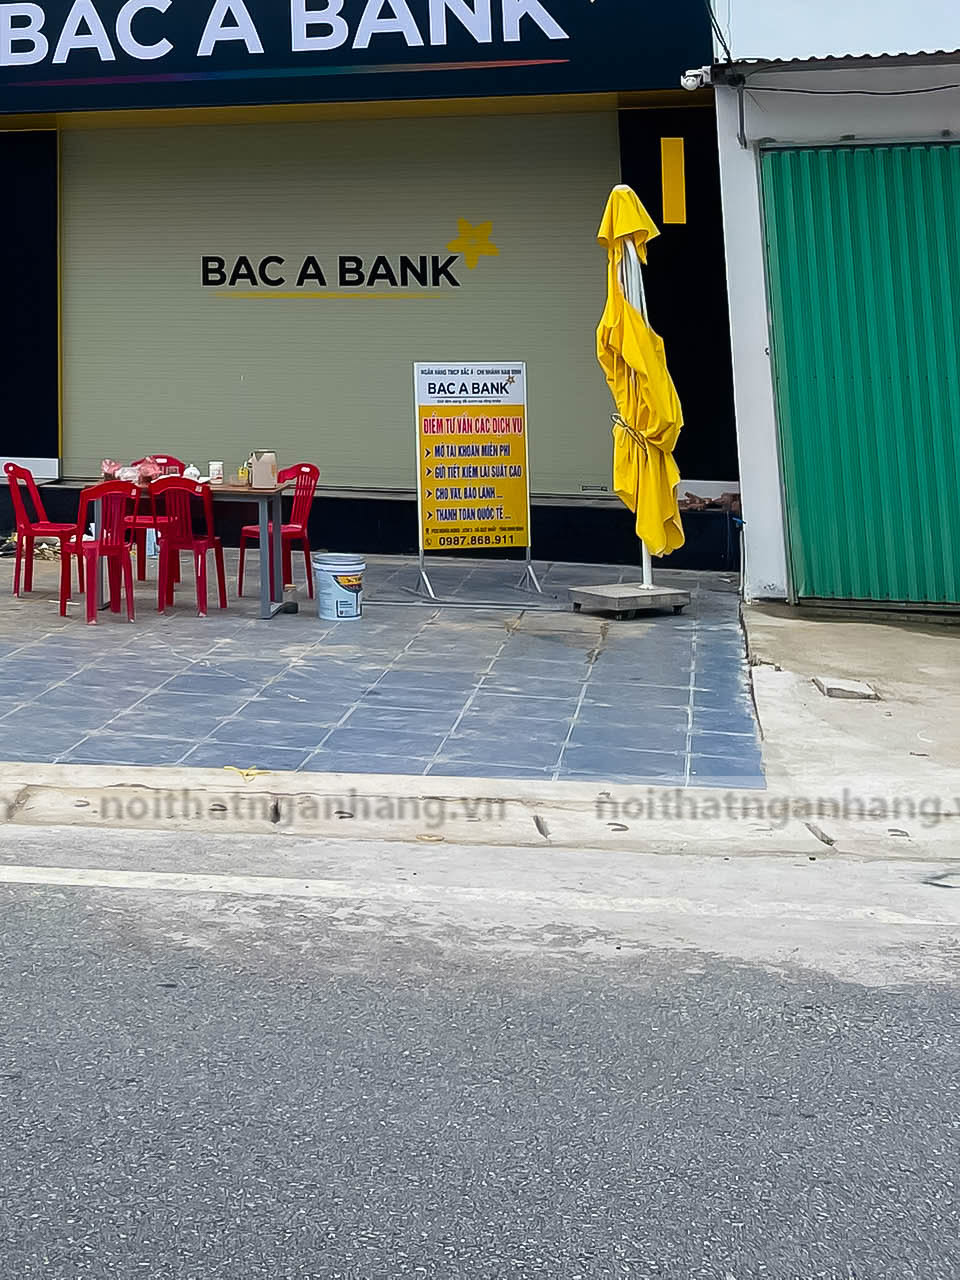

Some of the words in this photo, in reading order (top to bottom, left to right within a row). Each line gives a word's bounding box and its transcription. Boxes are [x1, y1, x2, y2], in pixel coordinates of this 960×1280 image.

[201, 255, 286, 287] BAC
[296, 255, 327, 287] A
[338, 255, 461, 287] BANK
[428, 382, 456, 395] BAC
[459, 382, 469, 395] A
[472, 382, 509, 395] BANK
[438, 535, 515, 546] 0987.868.911
